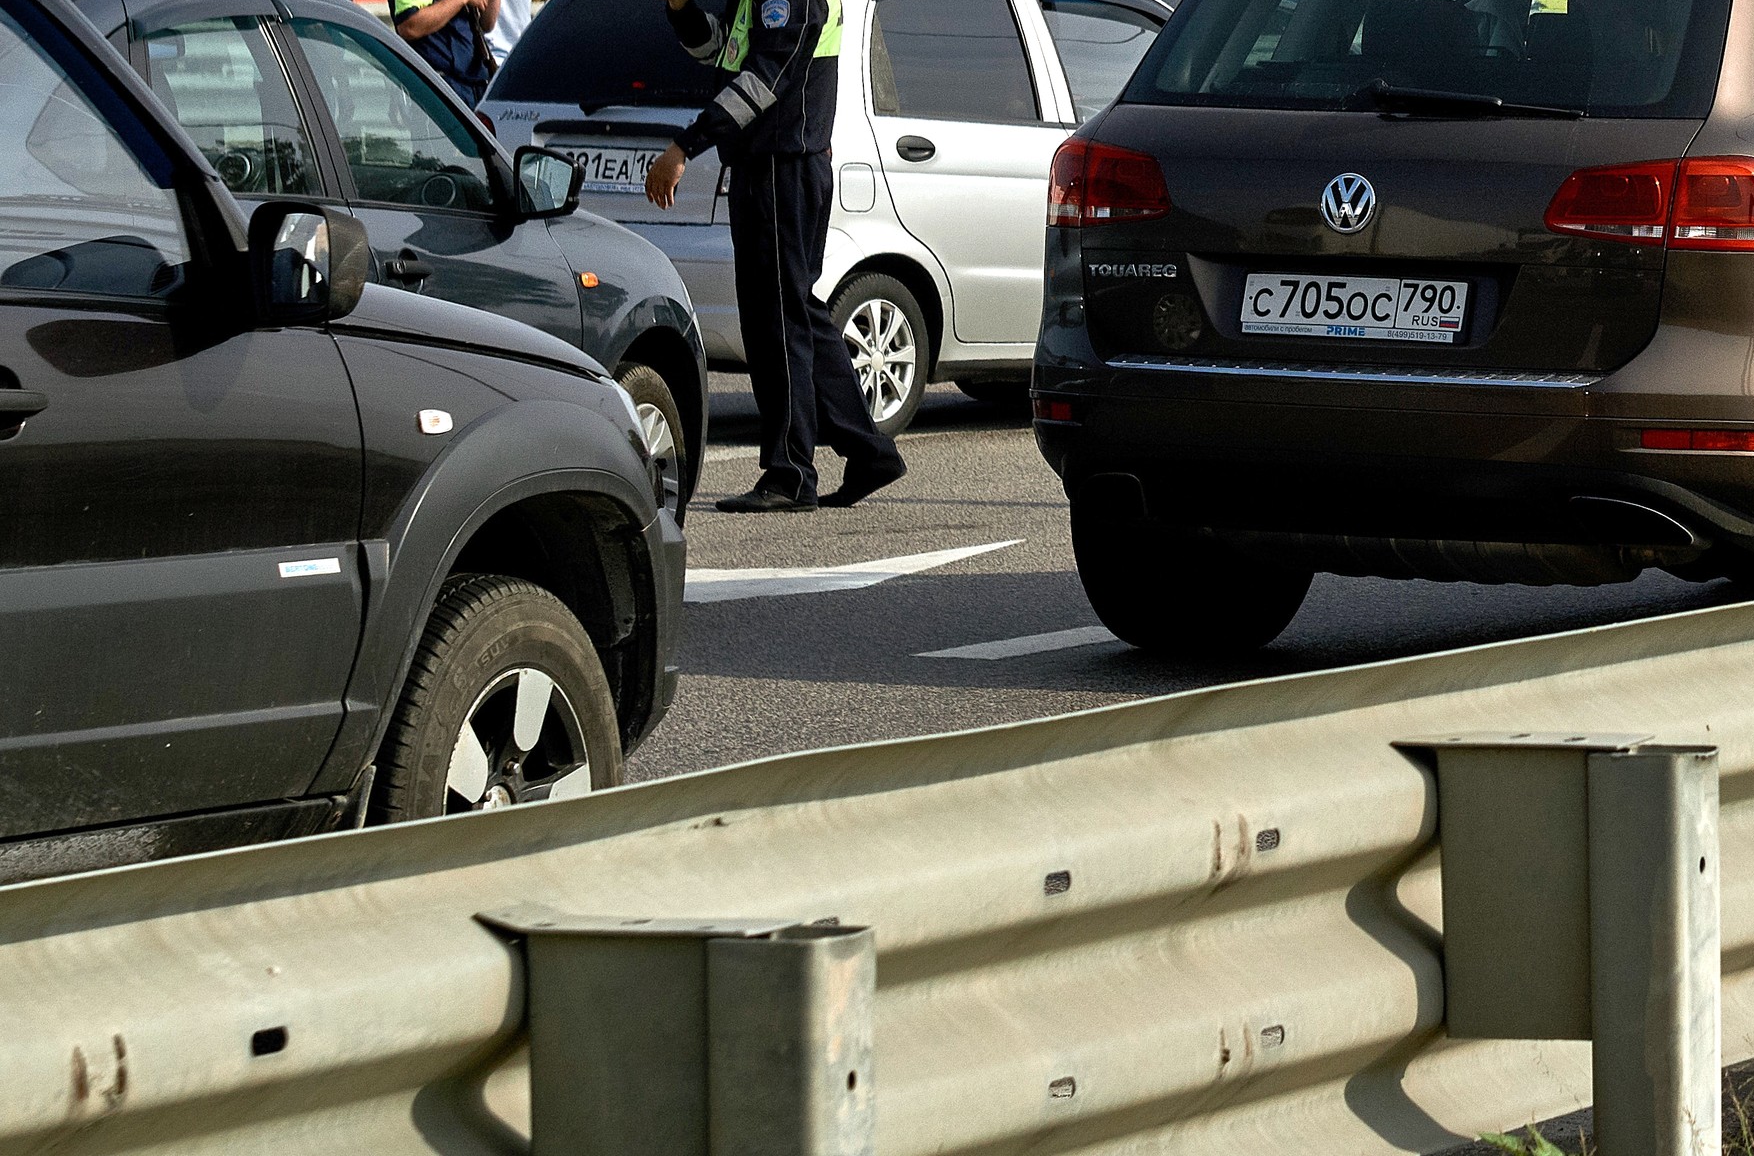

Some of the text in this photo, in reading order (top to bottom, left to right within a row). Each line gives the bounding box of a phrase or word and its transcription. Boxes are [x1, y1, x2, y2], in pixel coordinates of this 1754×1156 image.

[1088, 264, 1177, 278] TOUAREG
[1403, 282, 1456, 314] 790
[1411, 315, 1438, 327] RUS
[1326, 325, 1366, 337] PRIME
